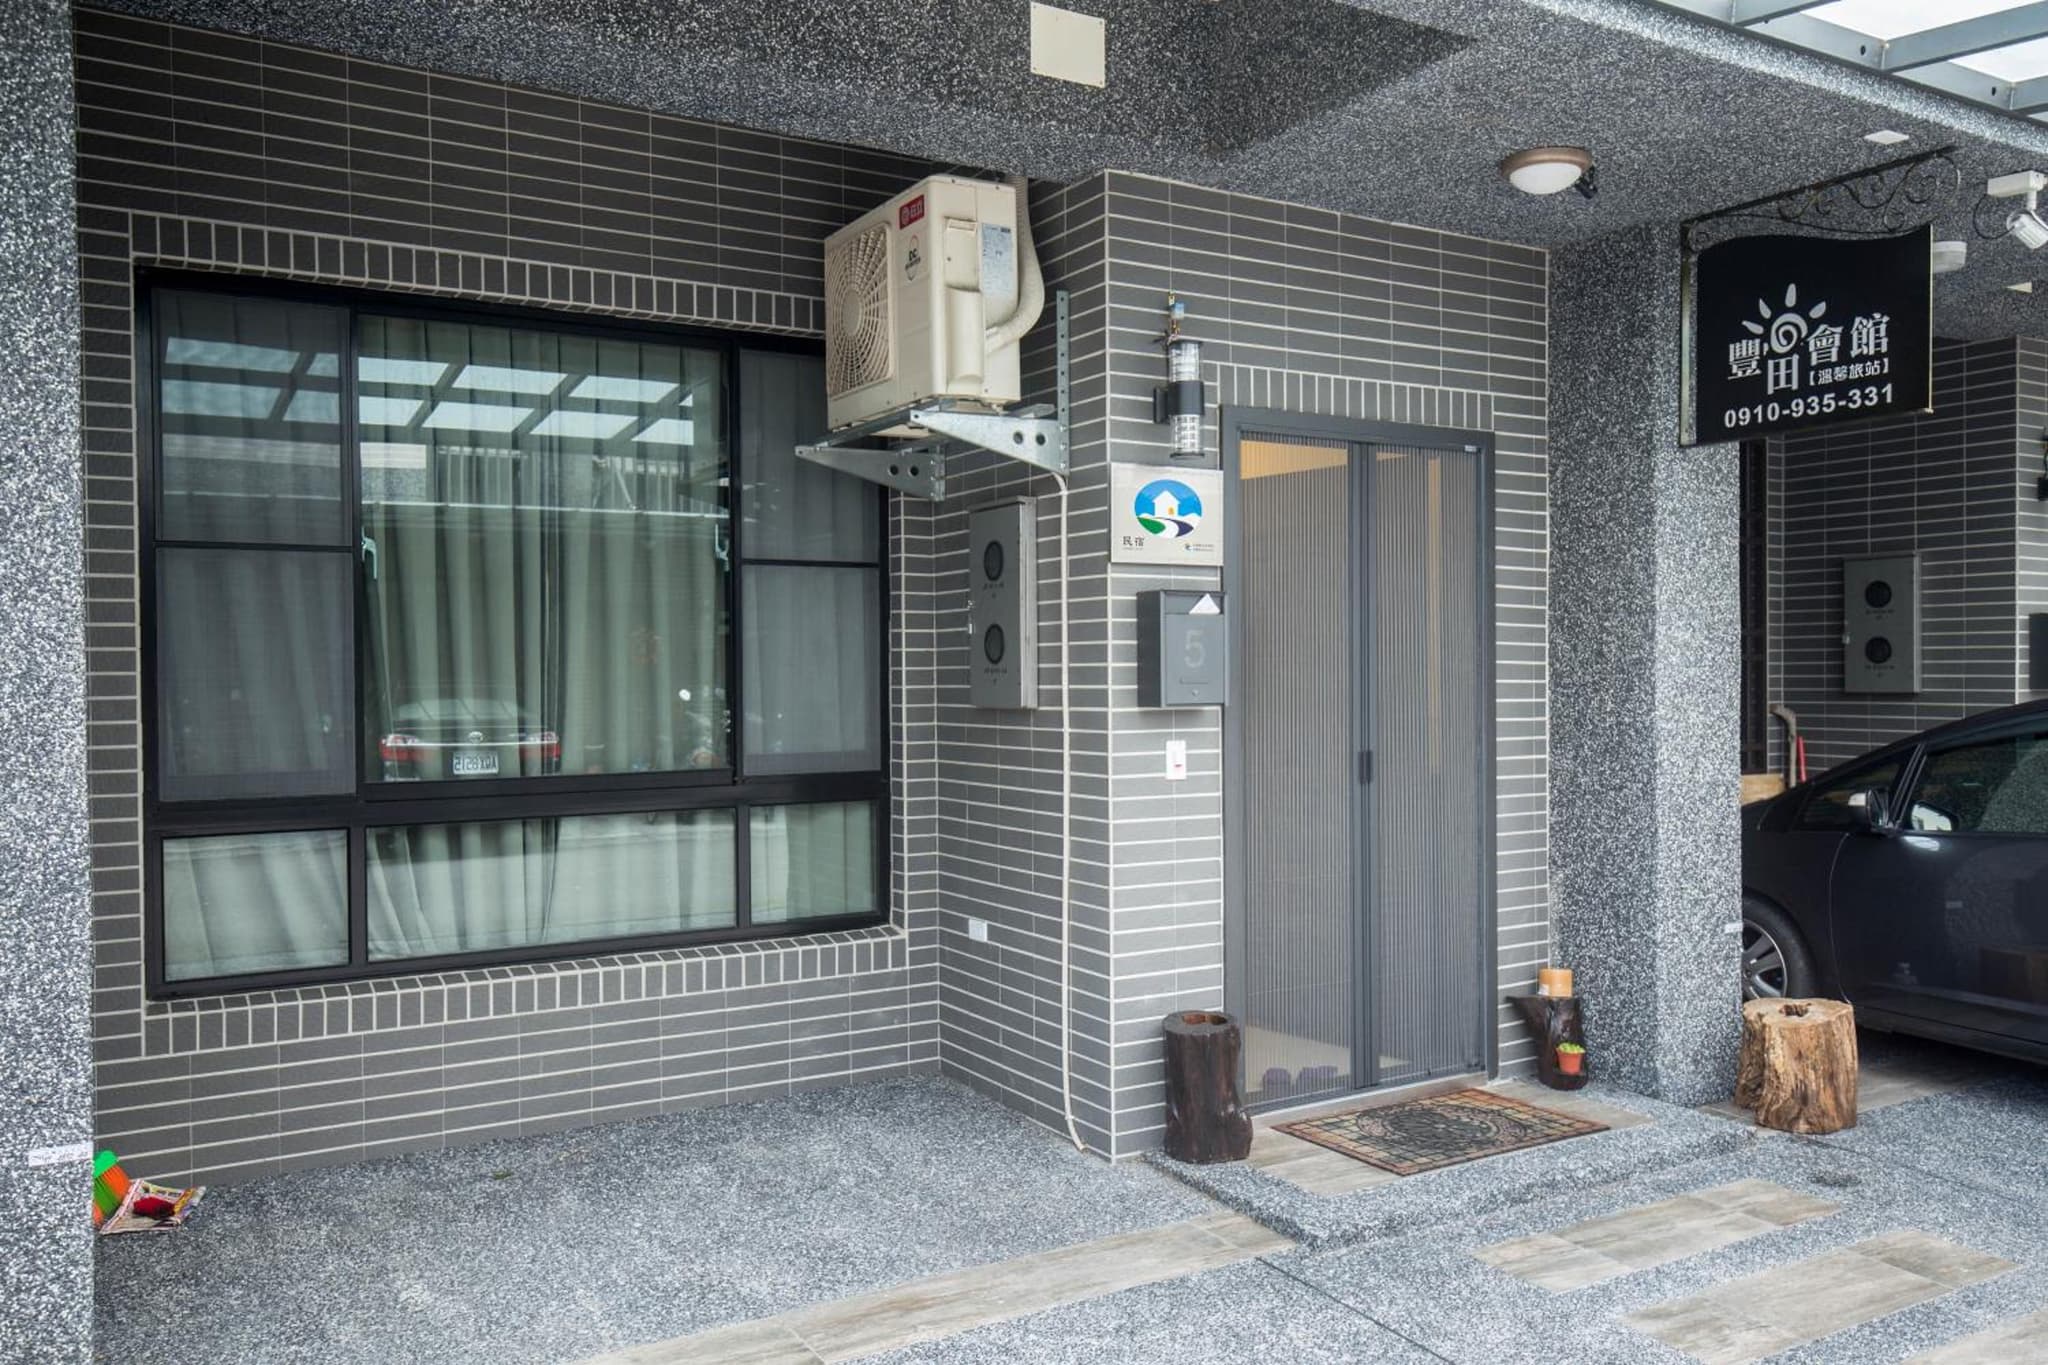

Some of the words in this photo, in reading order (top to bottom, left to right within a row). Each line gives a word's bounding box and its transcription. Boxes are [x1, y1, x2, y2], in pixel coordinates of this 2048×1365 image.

[1727, 312, 1890, 395] 豐田會館
[1724, 383, 1893, 428] 0910-935-331
[1122, 535, 1145, 547] 民宿
[1184, 629, 1206, 668] 5
